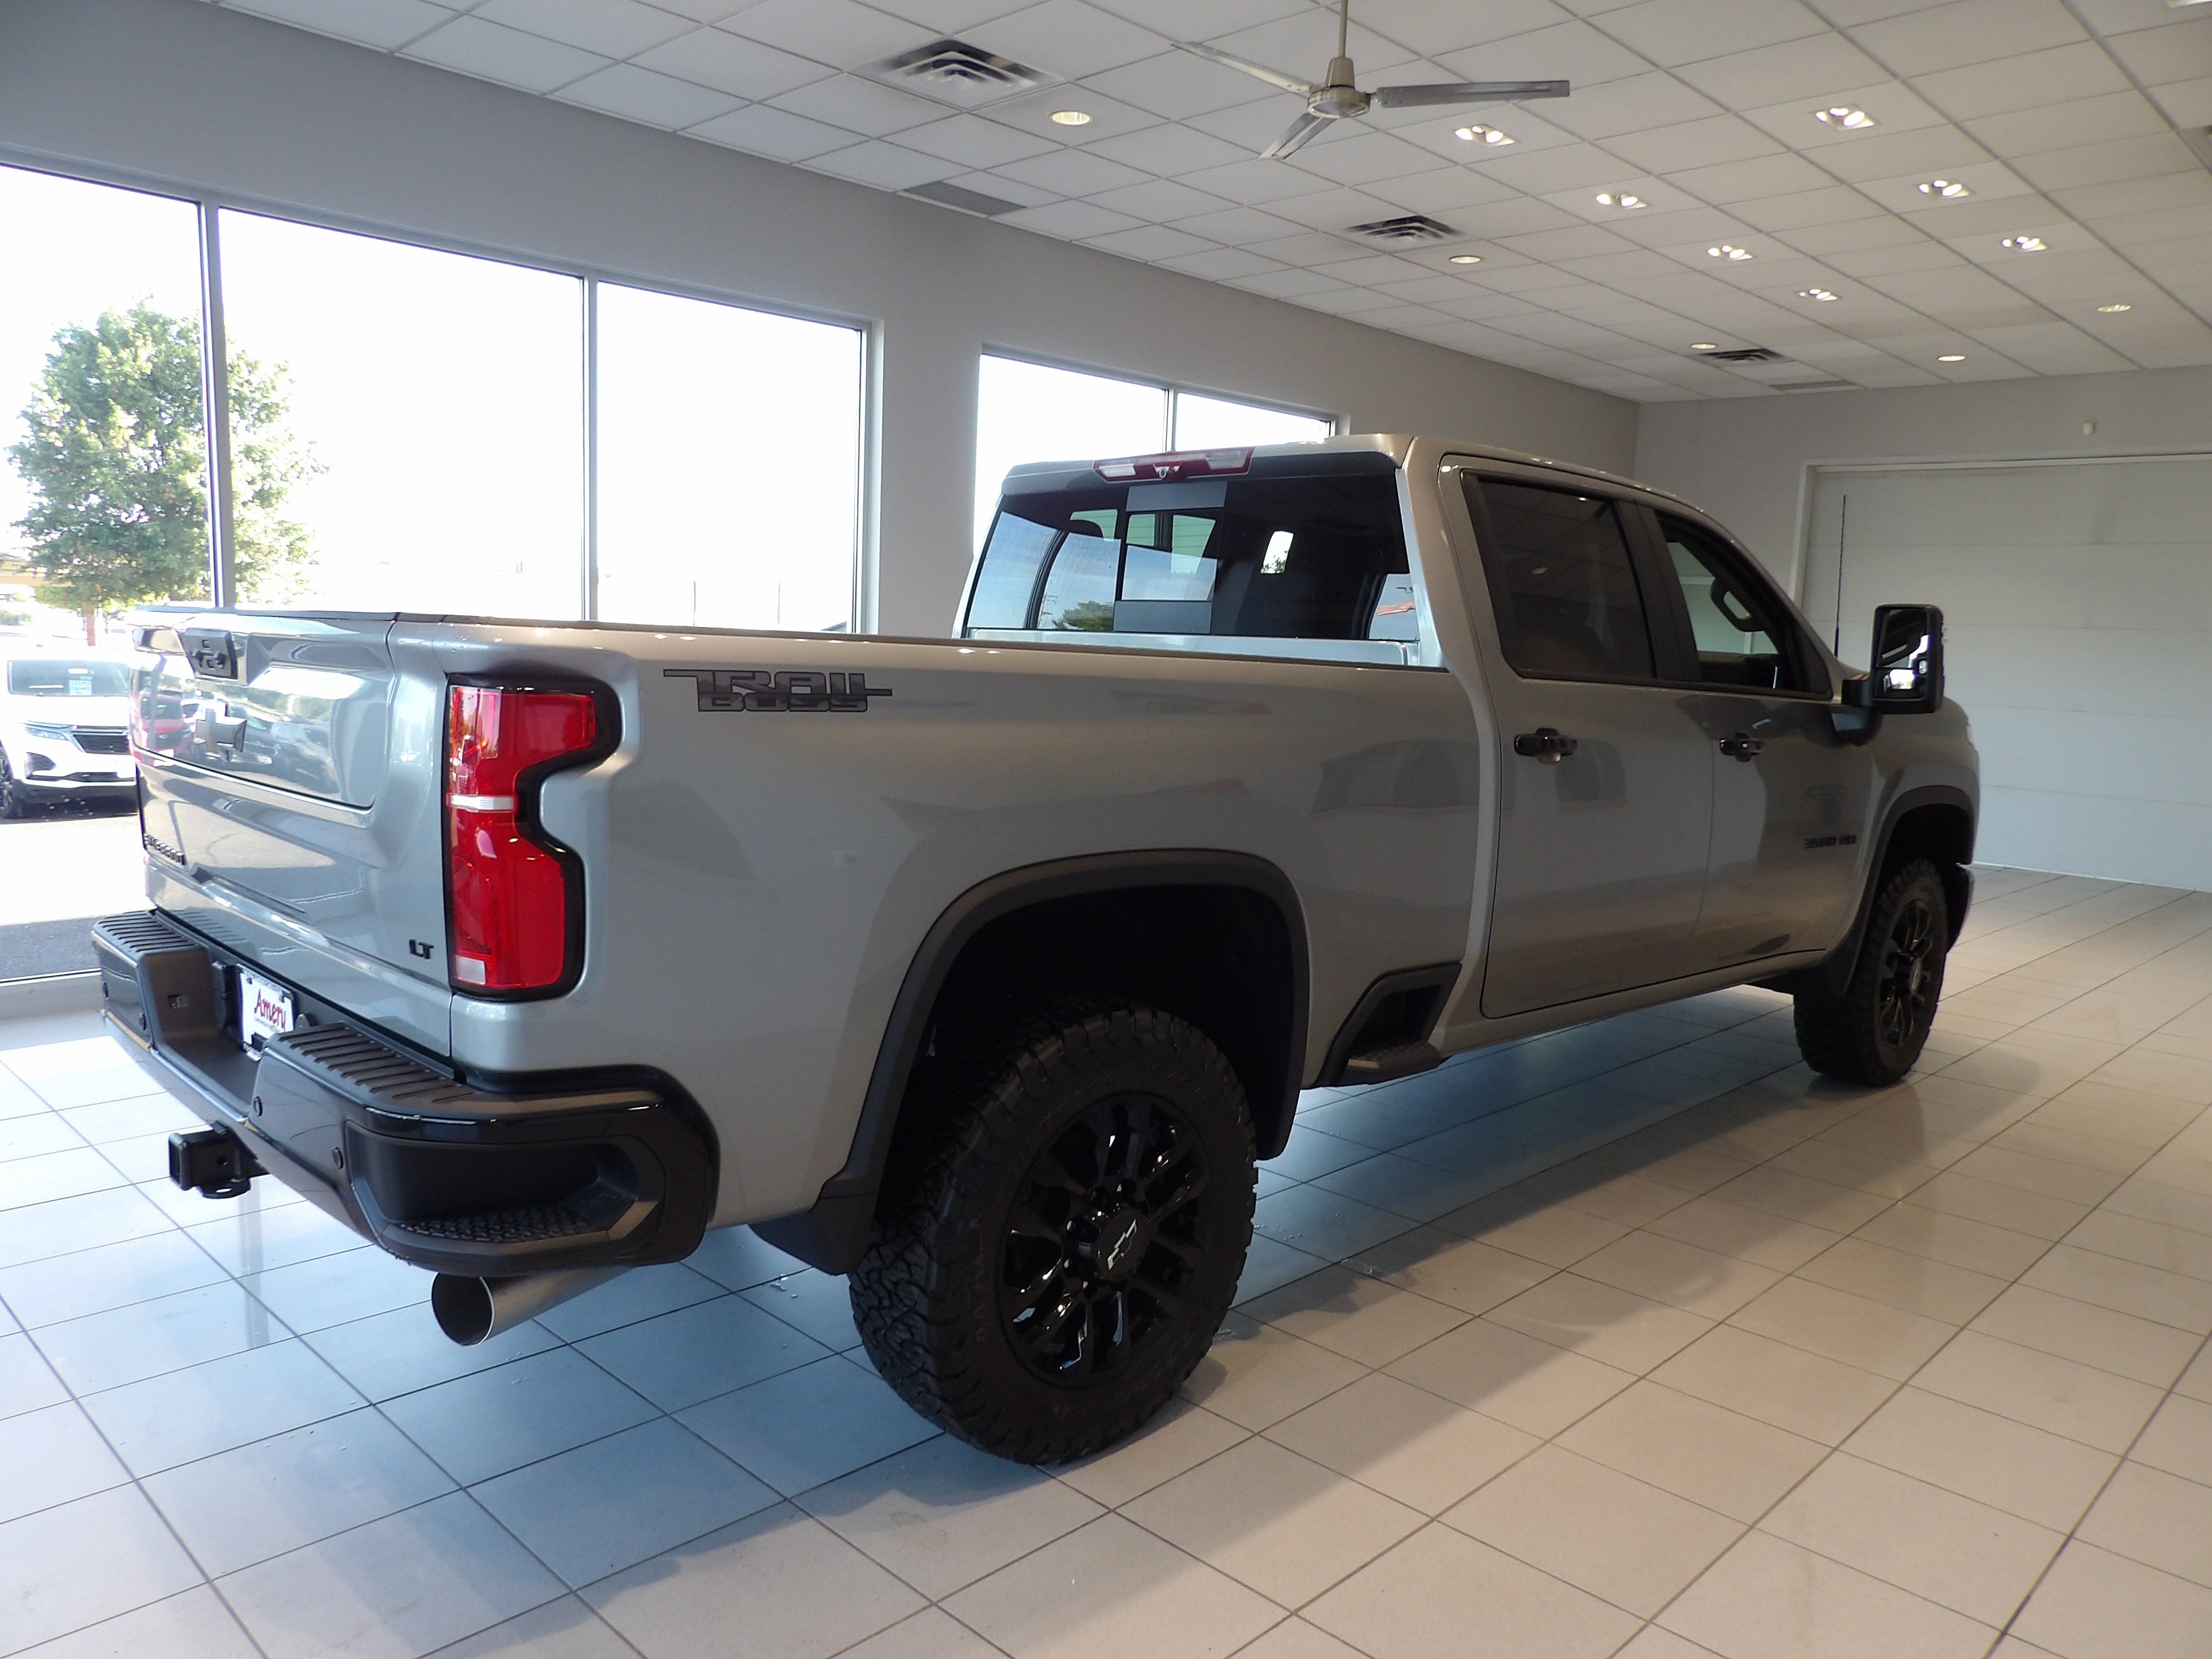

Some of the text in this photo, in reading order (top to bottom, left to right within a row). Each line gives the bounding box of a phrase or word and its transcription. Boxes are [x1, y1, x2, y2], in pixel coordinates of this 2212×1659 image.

[663, 669, 893, 696] TRAIL
[697, 693, 868, 712] BOSS
[409, 938, 434, 960] LT
[254, 988, 286, 1032] Amery
